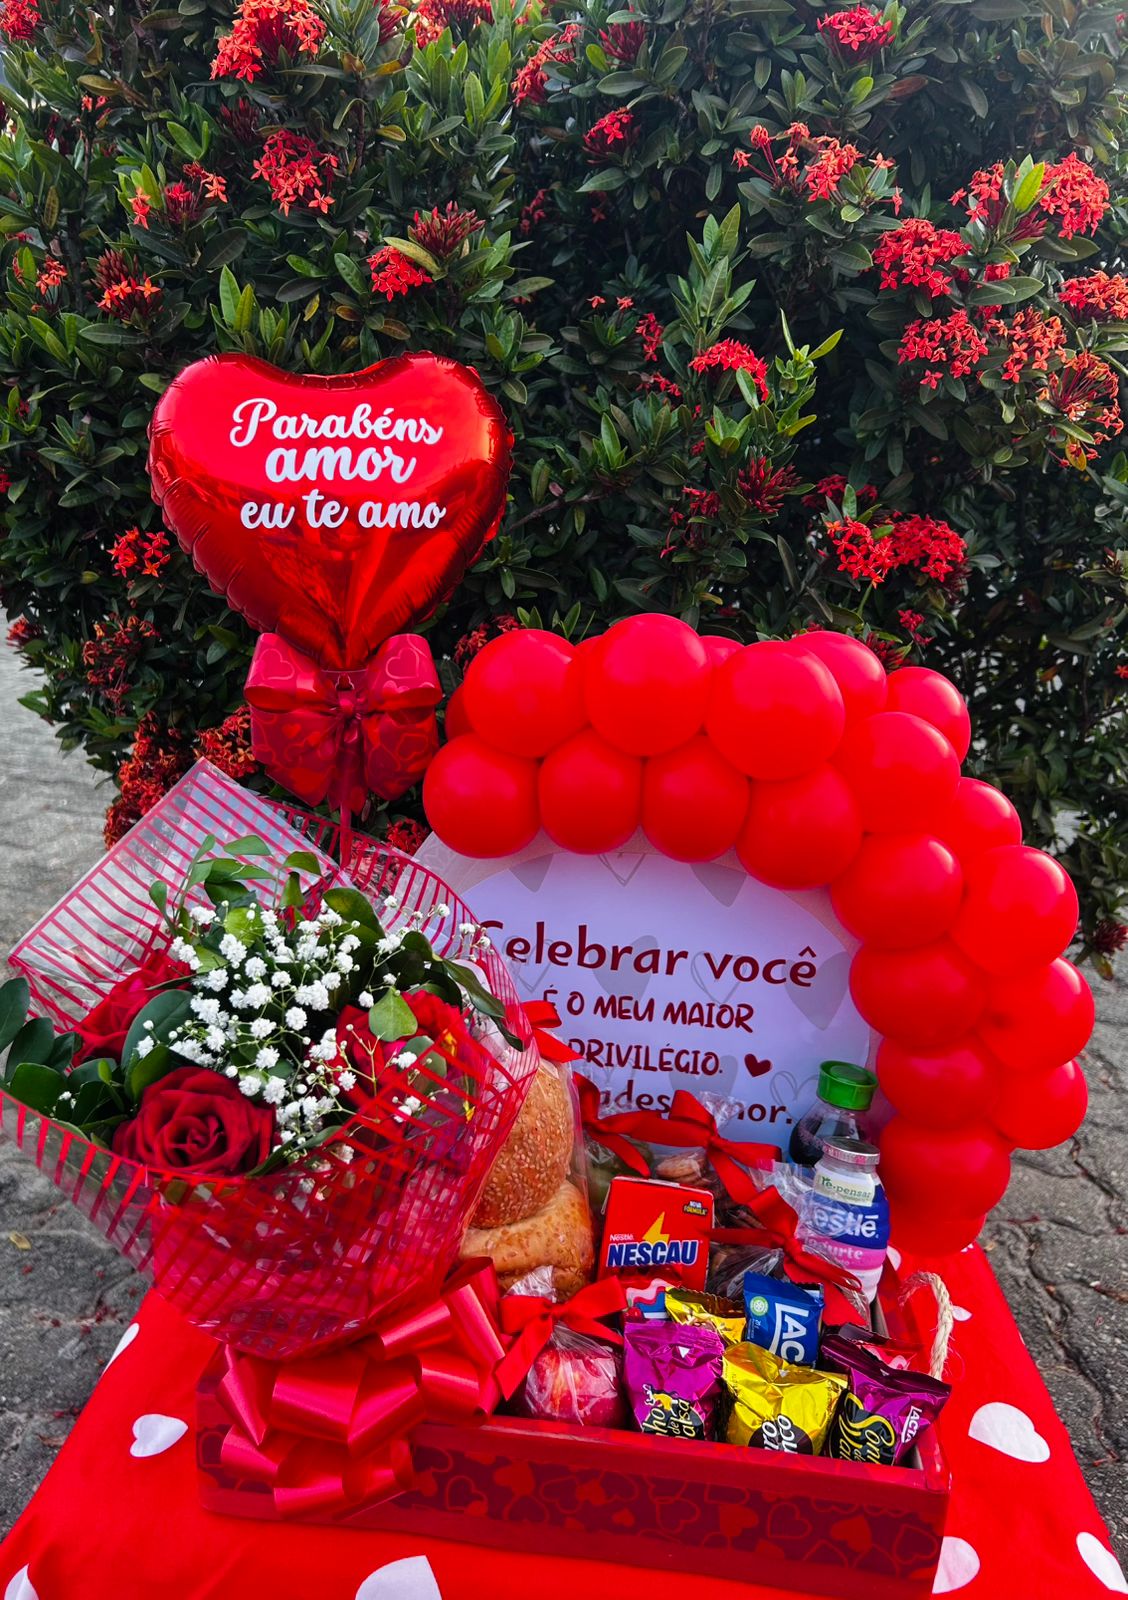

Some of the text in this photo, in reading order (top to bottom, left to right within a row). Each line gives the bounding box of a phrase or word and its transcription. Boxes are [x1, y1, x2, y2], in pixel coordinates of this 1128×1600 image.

[229, 398, 443, 447] Parabéns
[265, 446, 416, 483] amor
[240, 489, 446, 529] eu te amo
[703, 946, 817, 987] você
[567, 991, 585, 1016] O
[593, 994, 654, 1023] MEU
[663, 1000, 754, 1033] MAIOR
[600, 1080, 671, 1114] ades
[814, 1207, 876, 1238] estlé
[606, 1240, 699, 1267] NESCAU
[769, 1302, 809, 1364] LAC
[670, 1399, 696, 1438] alsa
[777, 1415, 798, 1455] nco
[844, 1392, 896, 1464] Son
[901, 1405, 923, 1443] LACTA
